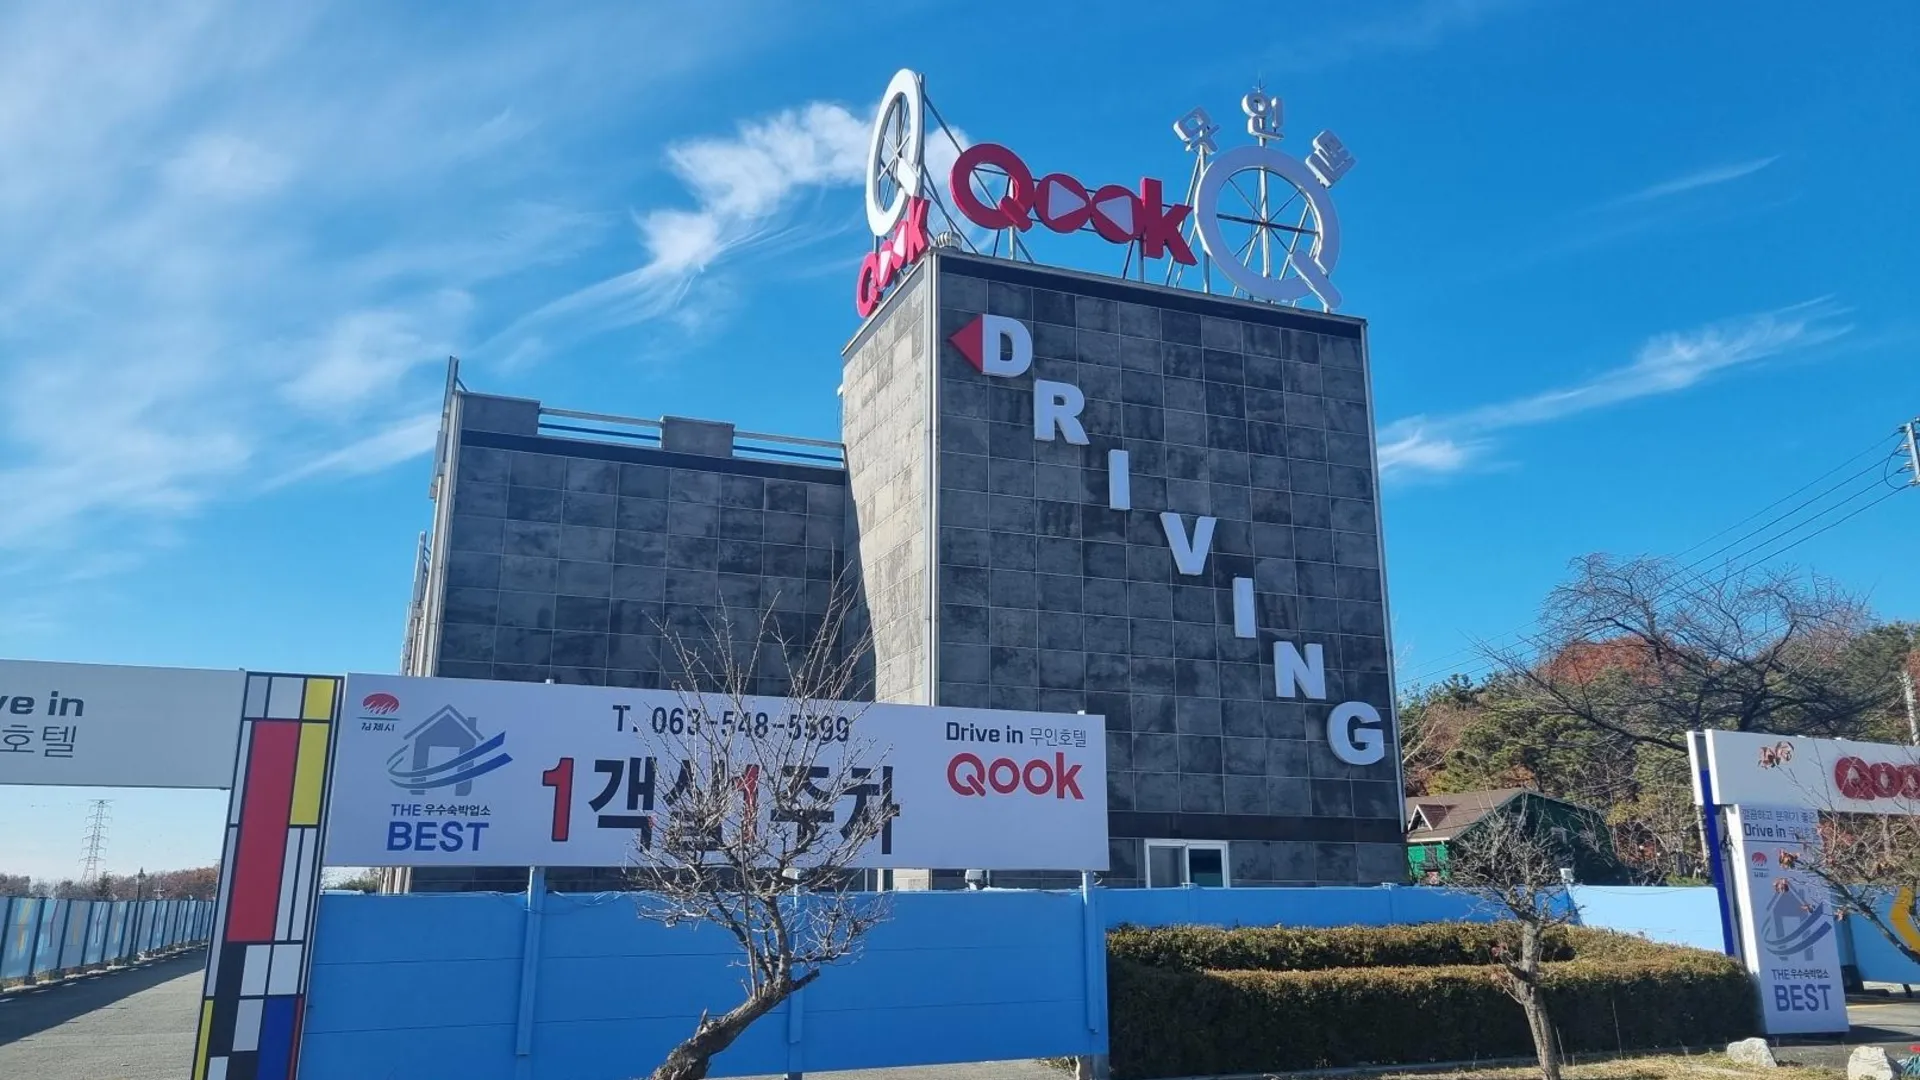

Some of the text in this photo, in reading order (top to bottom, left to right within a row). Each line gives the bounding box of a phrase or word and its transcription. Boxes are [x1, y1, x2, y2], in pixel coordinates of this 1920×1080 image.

[950, 143, 1198, 266] Qook
[47, 690, 84, 717] in
[0, 724, 77, 758] 호텔
[946, 721, 1087, 748] Drive in 무인호텔
[947, 752, 1085, 799] Qook
[391, 803, 491, 817] THE 우수숙박업소
[387, 820, 490, 852] BEST
[1744, 823, 1773, 838] Drive
[1776, 824, 1787, 838] in
[1771, 969, 1790, 980] THE
[1774, 984, 1831, 1012] BEST
